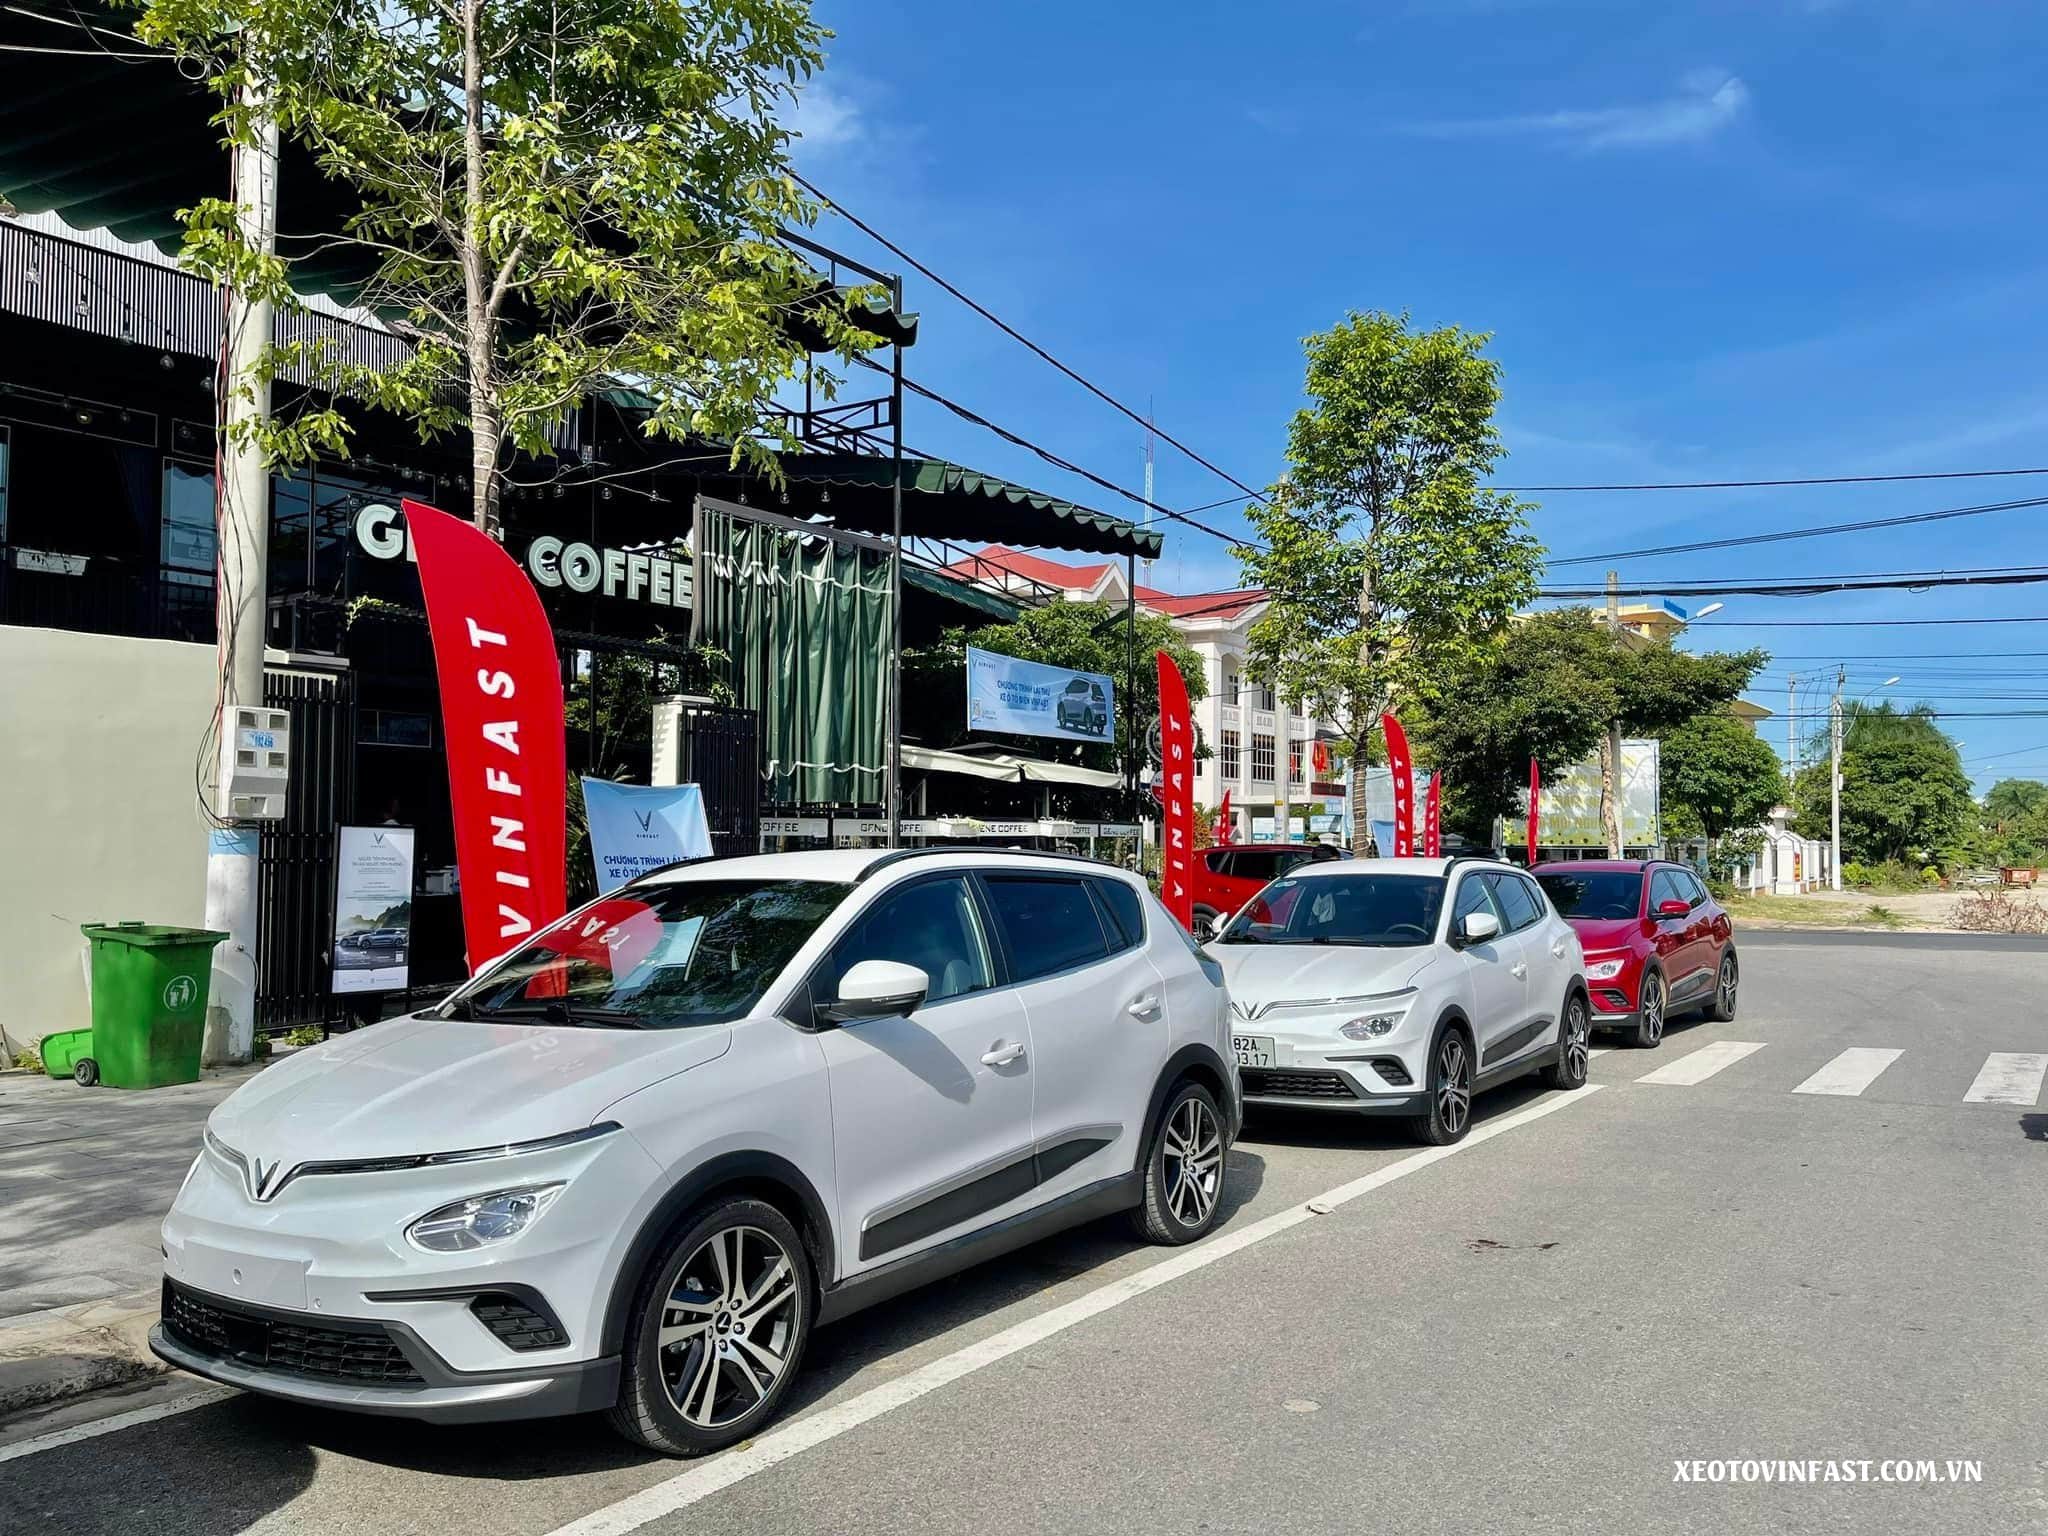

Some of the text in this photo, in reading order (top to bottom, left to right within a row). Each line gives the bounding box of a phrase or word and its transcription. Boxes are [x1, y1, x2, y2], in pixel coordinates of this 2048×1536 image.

[529, 535, 694, 610] COFFEE
[465, 617, 531, 938] VINFAST
[759, 822, 799, 832] OFFEE
[1169, 714, 1184, 898] VINFAST
[998, 824, 1029, 833] COFFEE
[609, 868, 620, 878] XE
